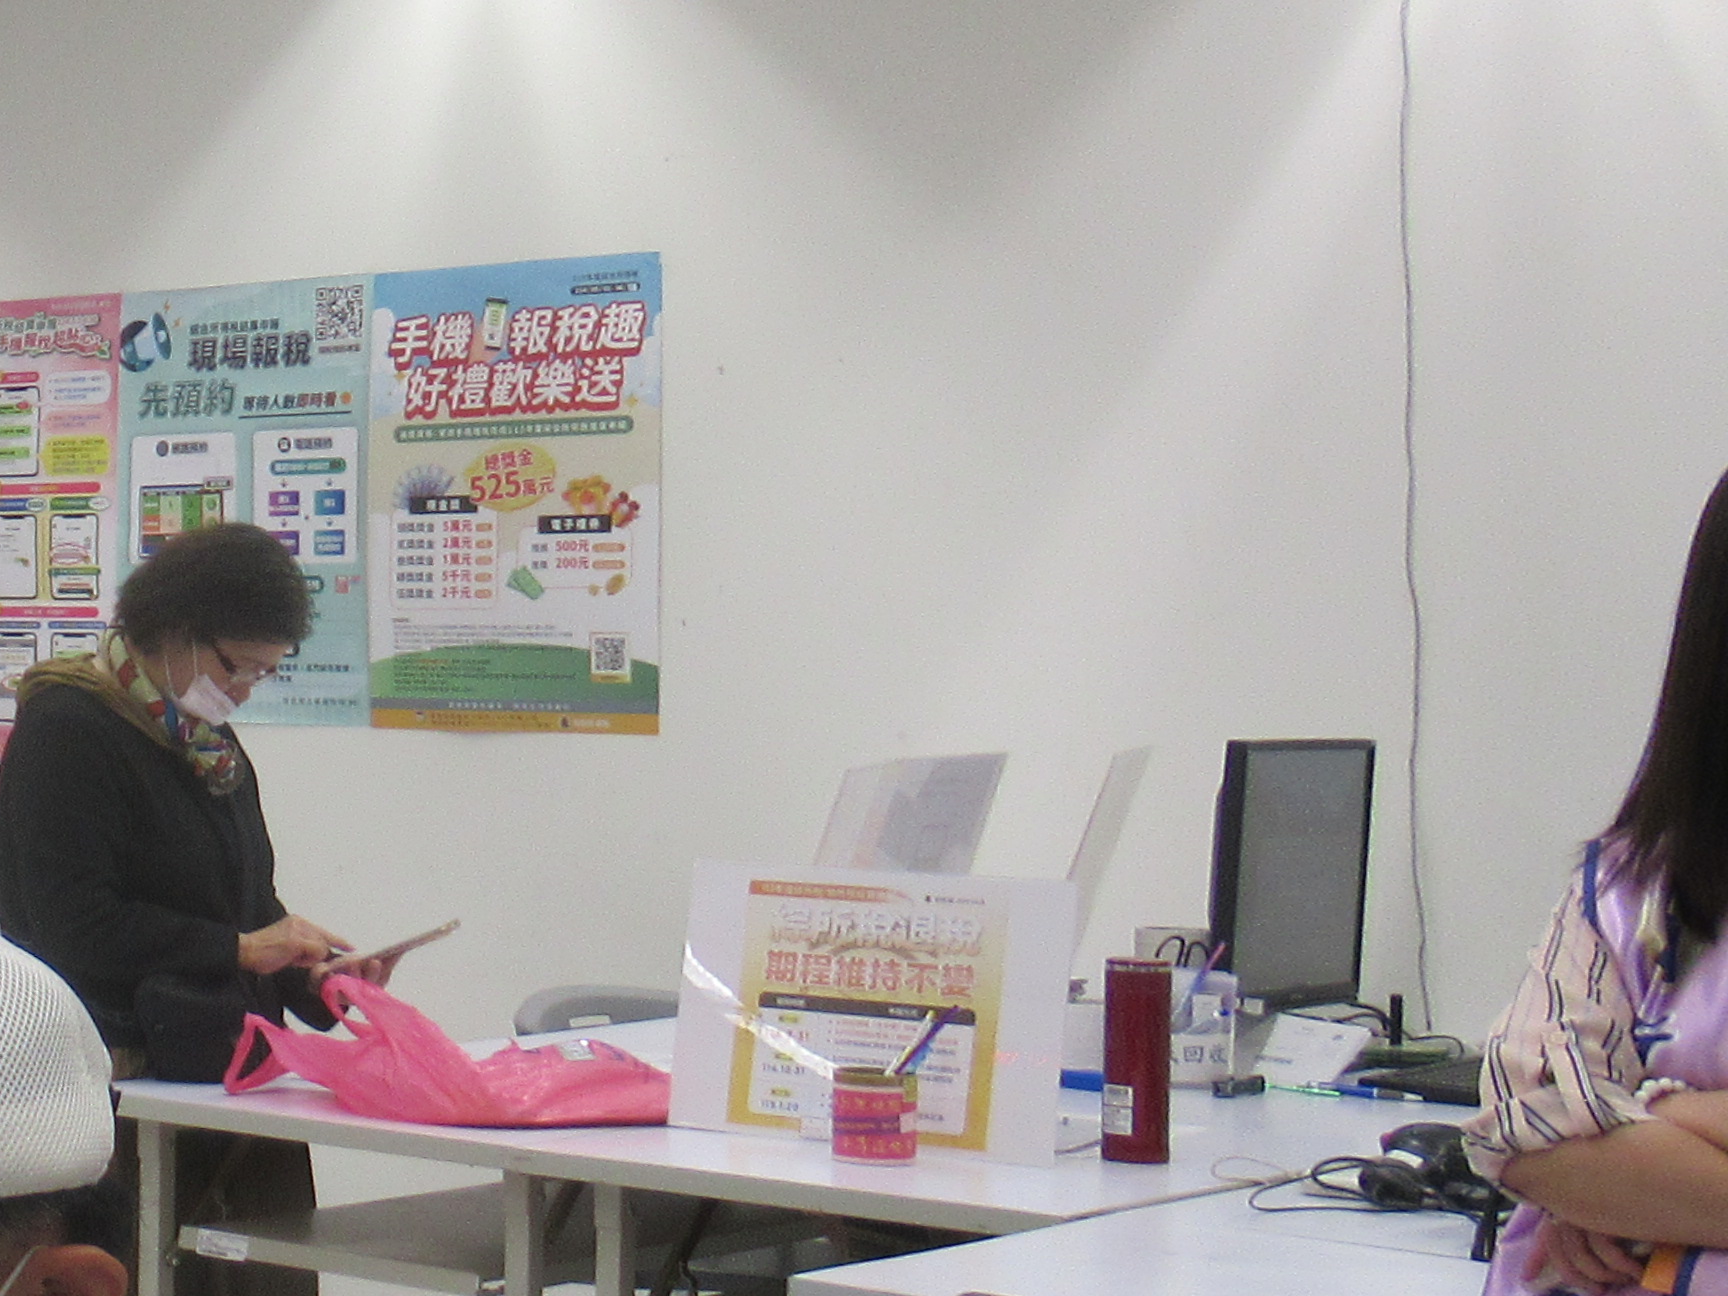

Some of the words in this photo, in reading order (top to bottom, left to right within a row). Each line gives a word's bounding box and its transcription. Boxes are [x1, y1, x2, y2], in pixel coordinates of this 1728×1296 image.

[187, 330, 313, 372] 現場報稅
[137, 378, 236, 418] 先預約
[406, 357, 624, 414] 好禮歡樂送
[469, 470, 555, 503] 525萬元
[766, 949, 975, 998] 期程維持不變
